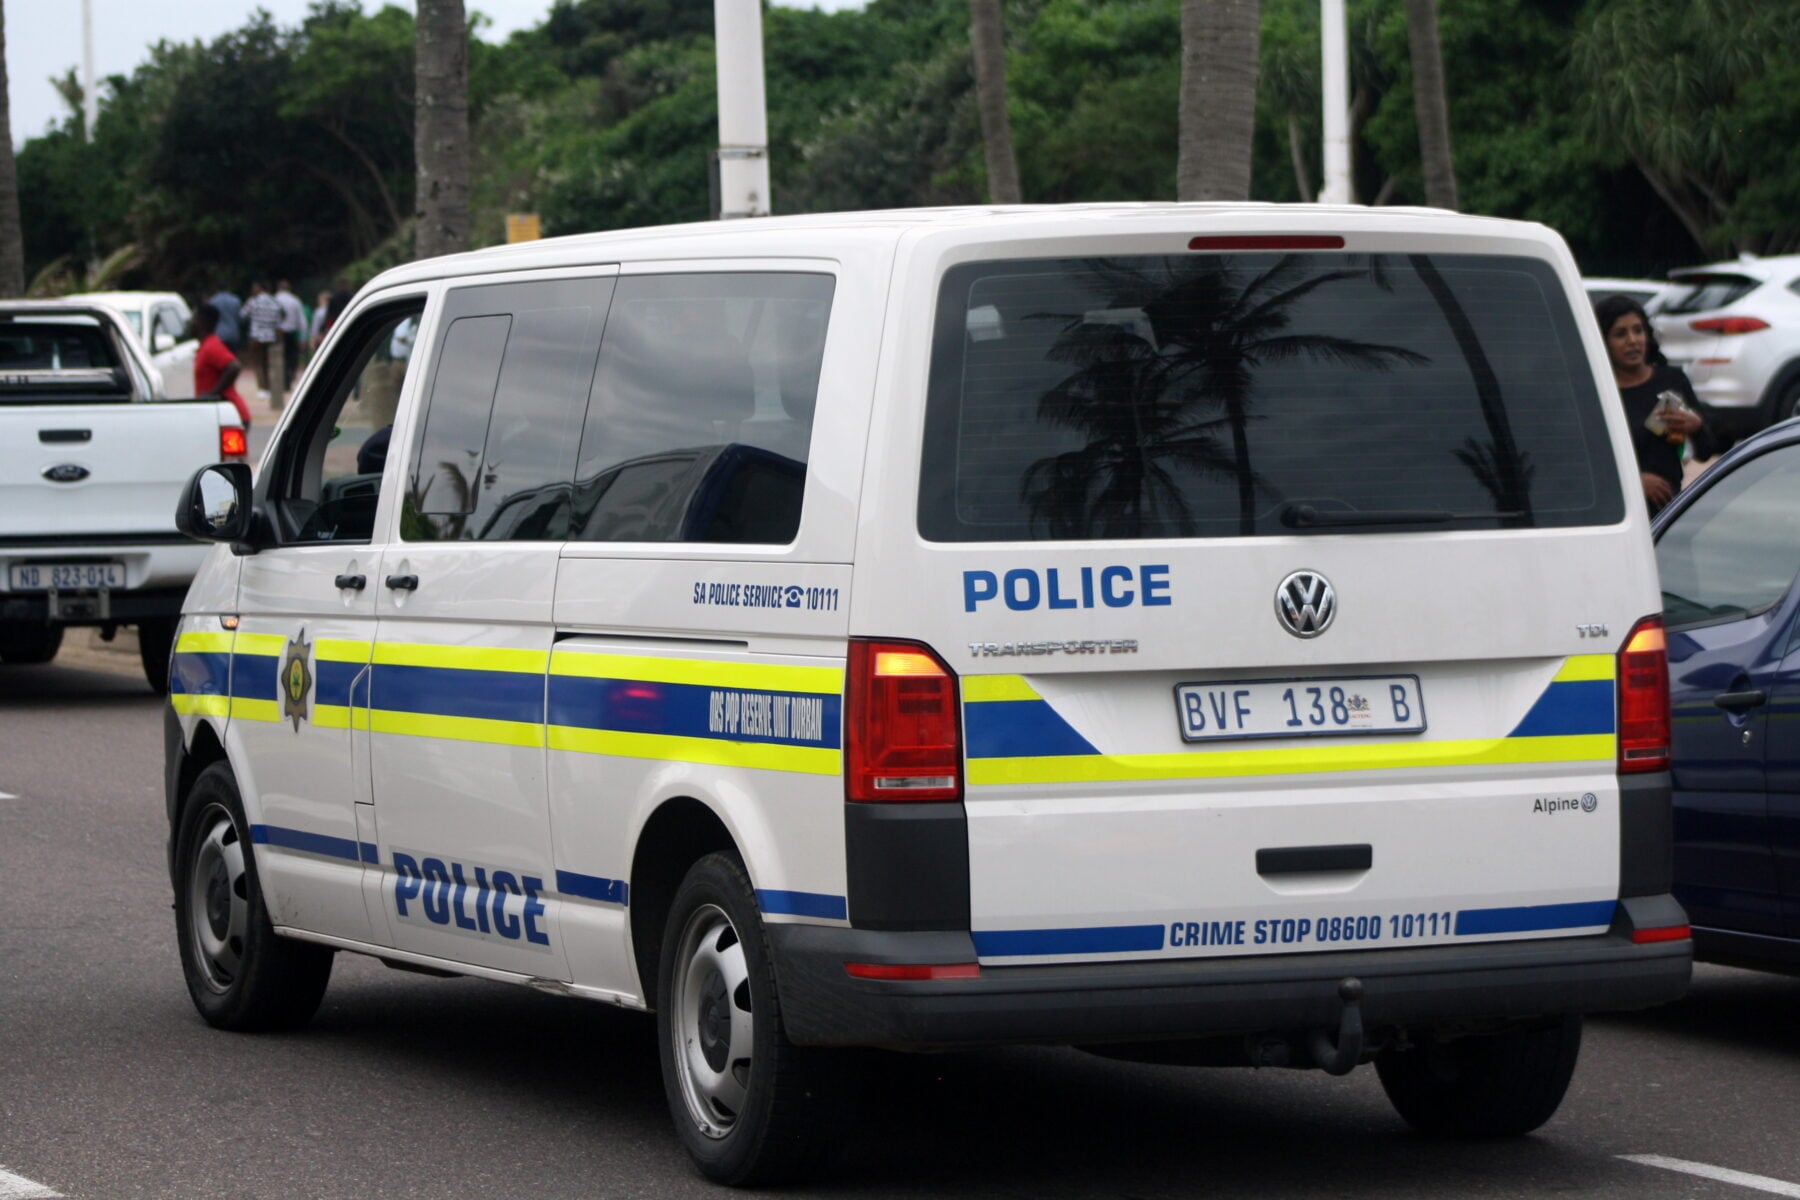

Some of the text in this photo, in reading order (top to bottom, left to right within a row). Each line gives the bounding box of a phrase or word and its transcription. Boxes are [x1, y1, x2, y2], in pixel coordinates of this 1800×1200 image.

[20, 563, 116, 585] ND 823-014
[962, 564, 1172, 613] POLICE
[693, 582, 839, 611] SA POLICE SERVICE 10111
[968, 639, 1138, 658] TRANSPORTER
[725, 692, 740, 734] POP
[741, 693, 772, 737] RESERVE
[773, 695, 791, 738] UNIT
[791, 697, 823, 741] DURBAN
[1183, 684, 1410, 732] BVF 138 B
[1533, 797, 1579, 815] Alpine
[392, 852, 549, 946] POLICE
[1169, 911, 1451, 947] CRIME STOP 08600 10111
